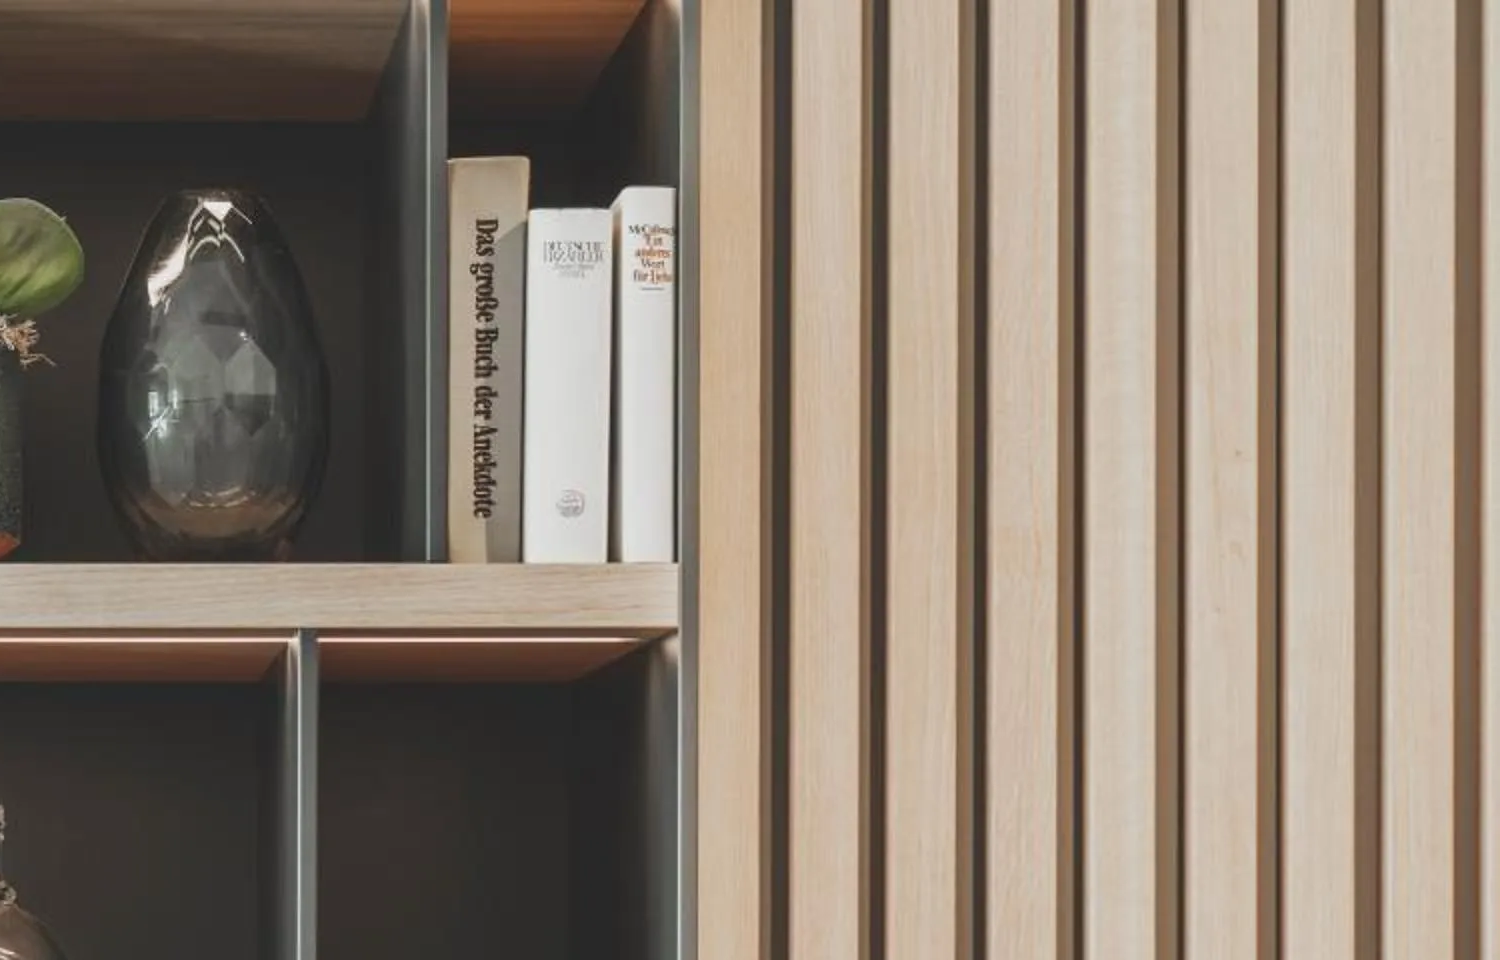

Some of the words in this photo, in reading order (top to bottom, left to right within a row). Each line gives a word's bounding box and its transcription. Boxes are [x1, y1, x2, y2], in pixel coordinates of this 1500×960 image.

[476, 219, 498, 257] Das
[470, 262, 498, 323] große
[474, 327, 498, 379] Buch
[474, 384, 497, 420] der
[473, 424, 498, 519] Anekdote
